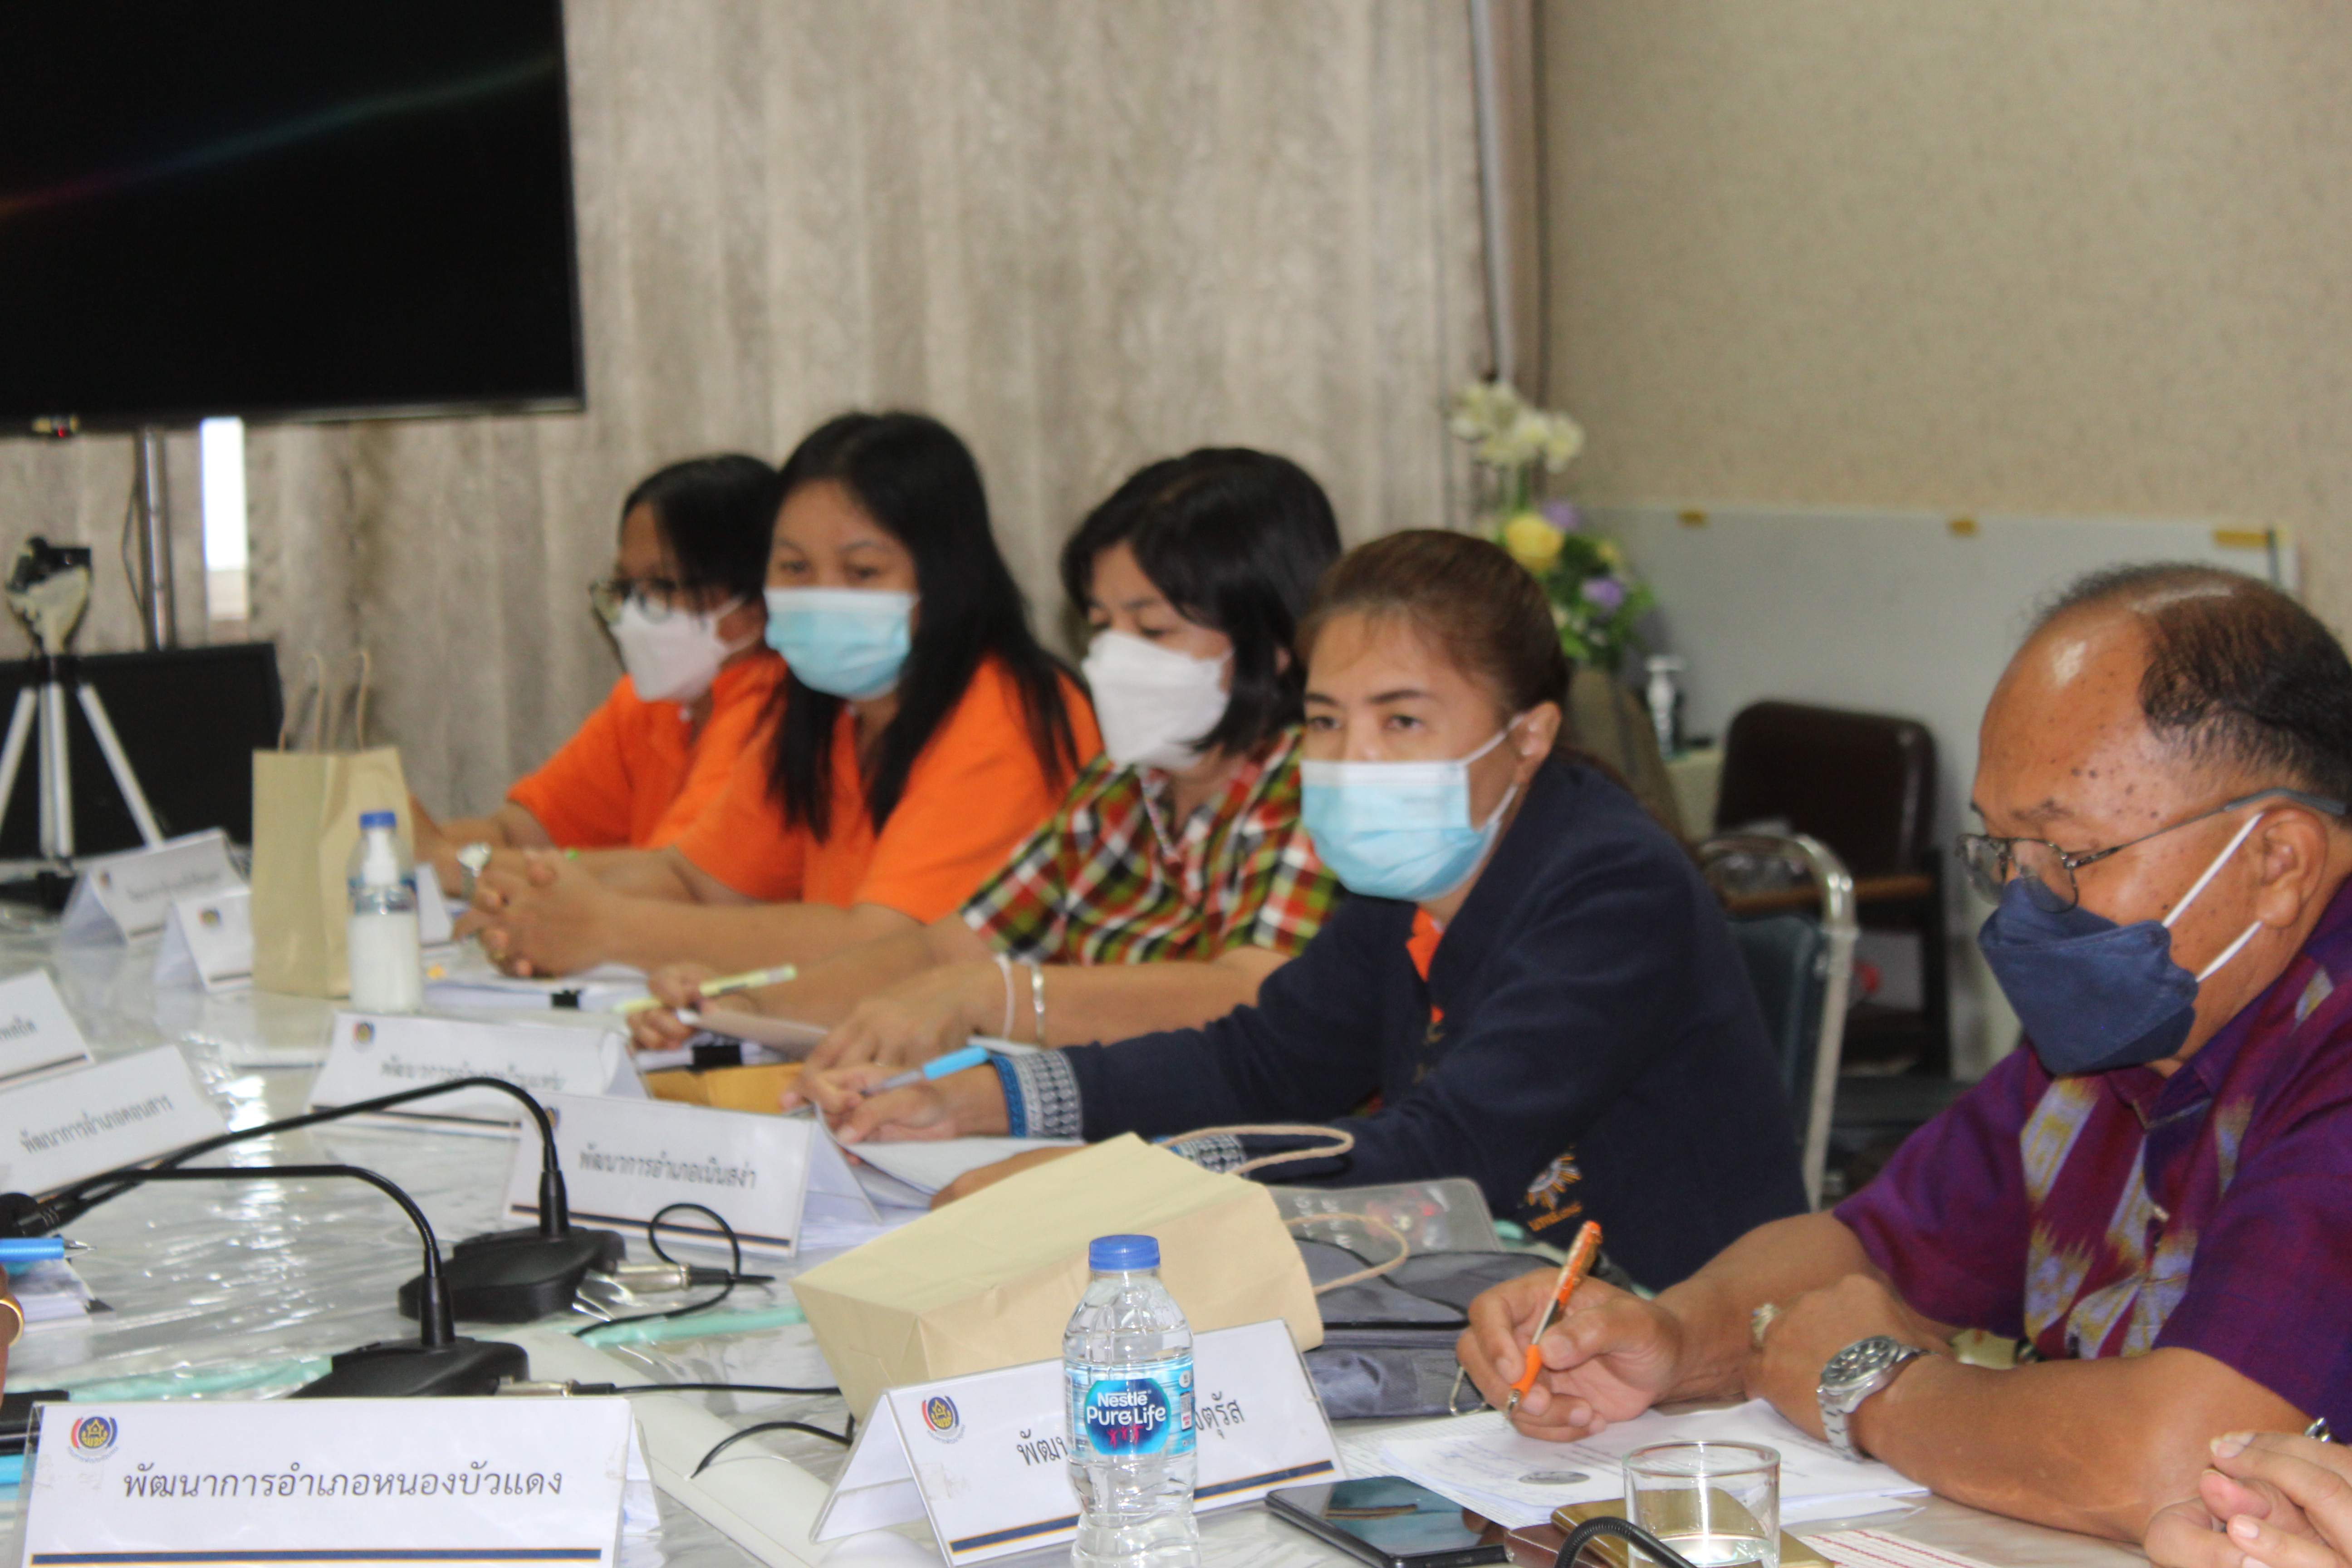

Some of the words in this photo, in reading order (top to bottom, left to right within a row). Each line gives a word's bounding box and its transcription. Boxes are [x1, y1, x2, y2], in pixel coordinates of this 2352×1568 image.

[124, 1460, 562, 1497] พัฒนาการอำเภอหนองบัวแดง
